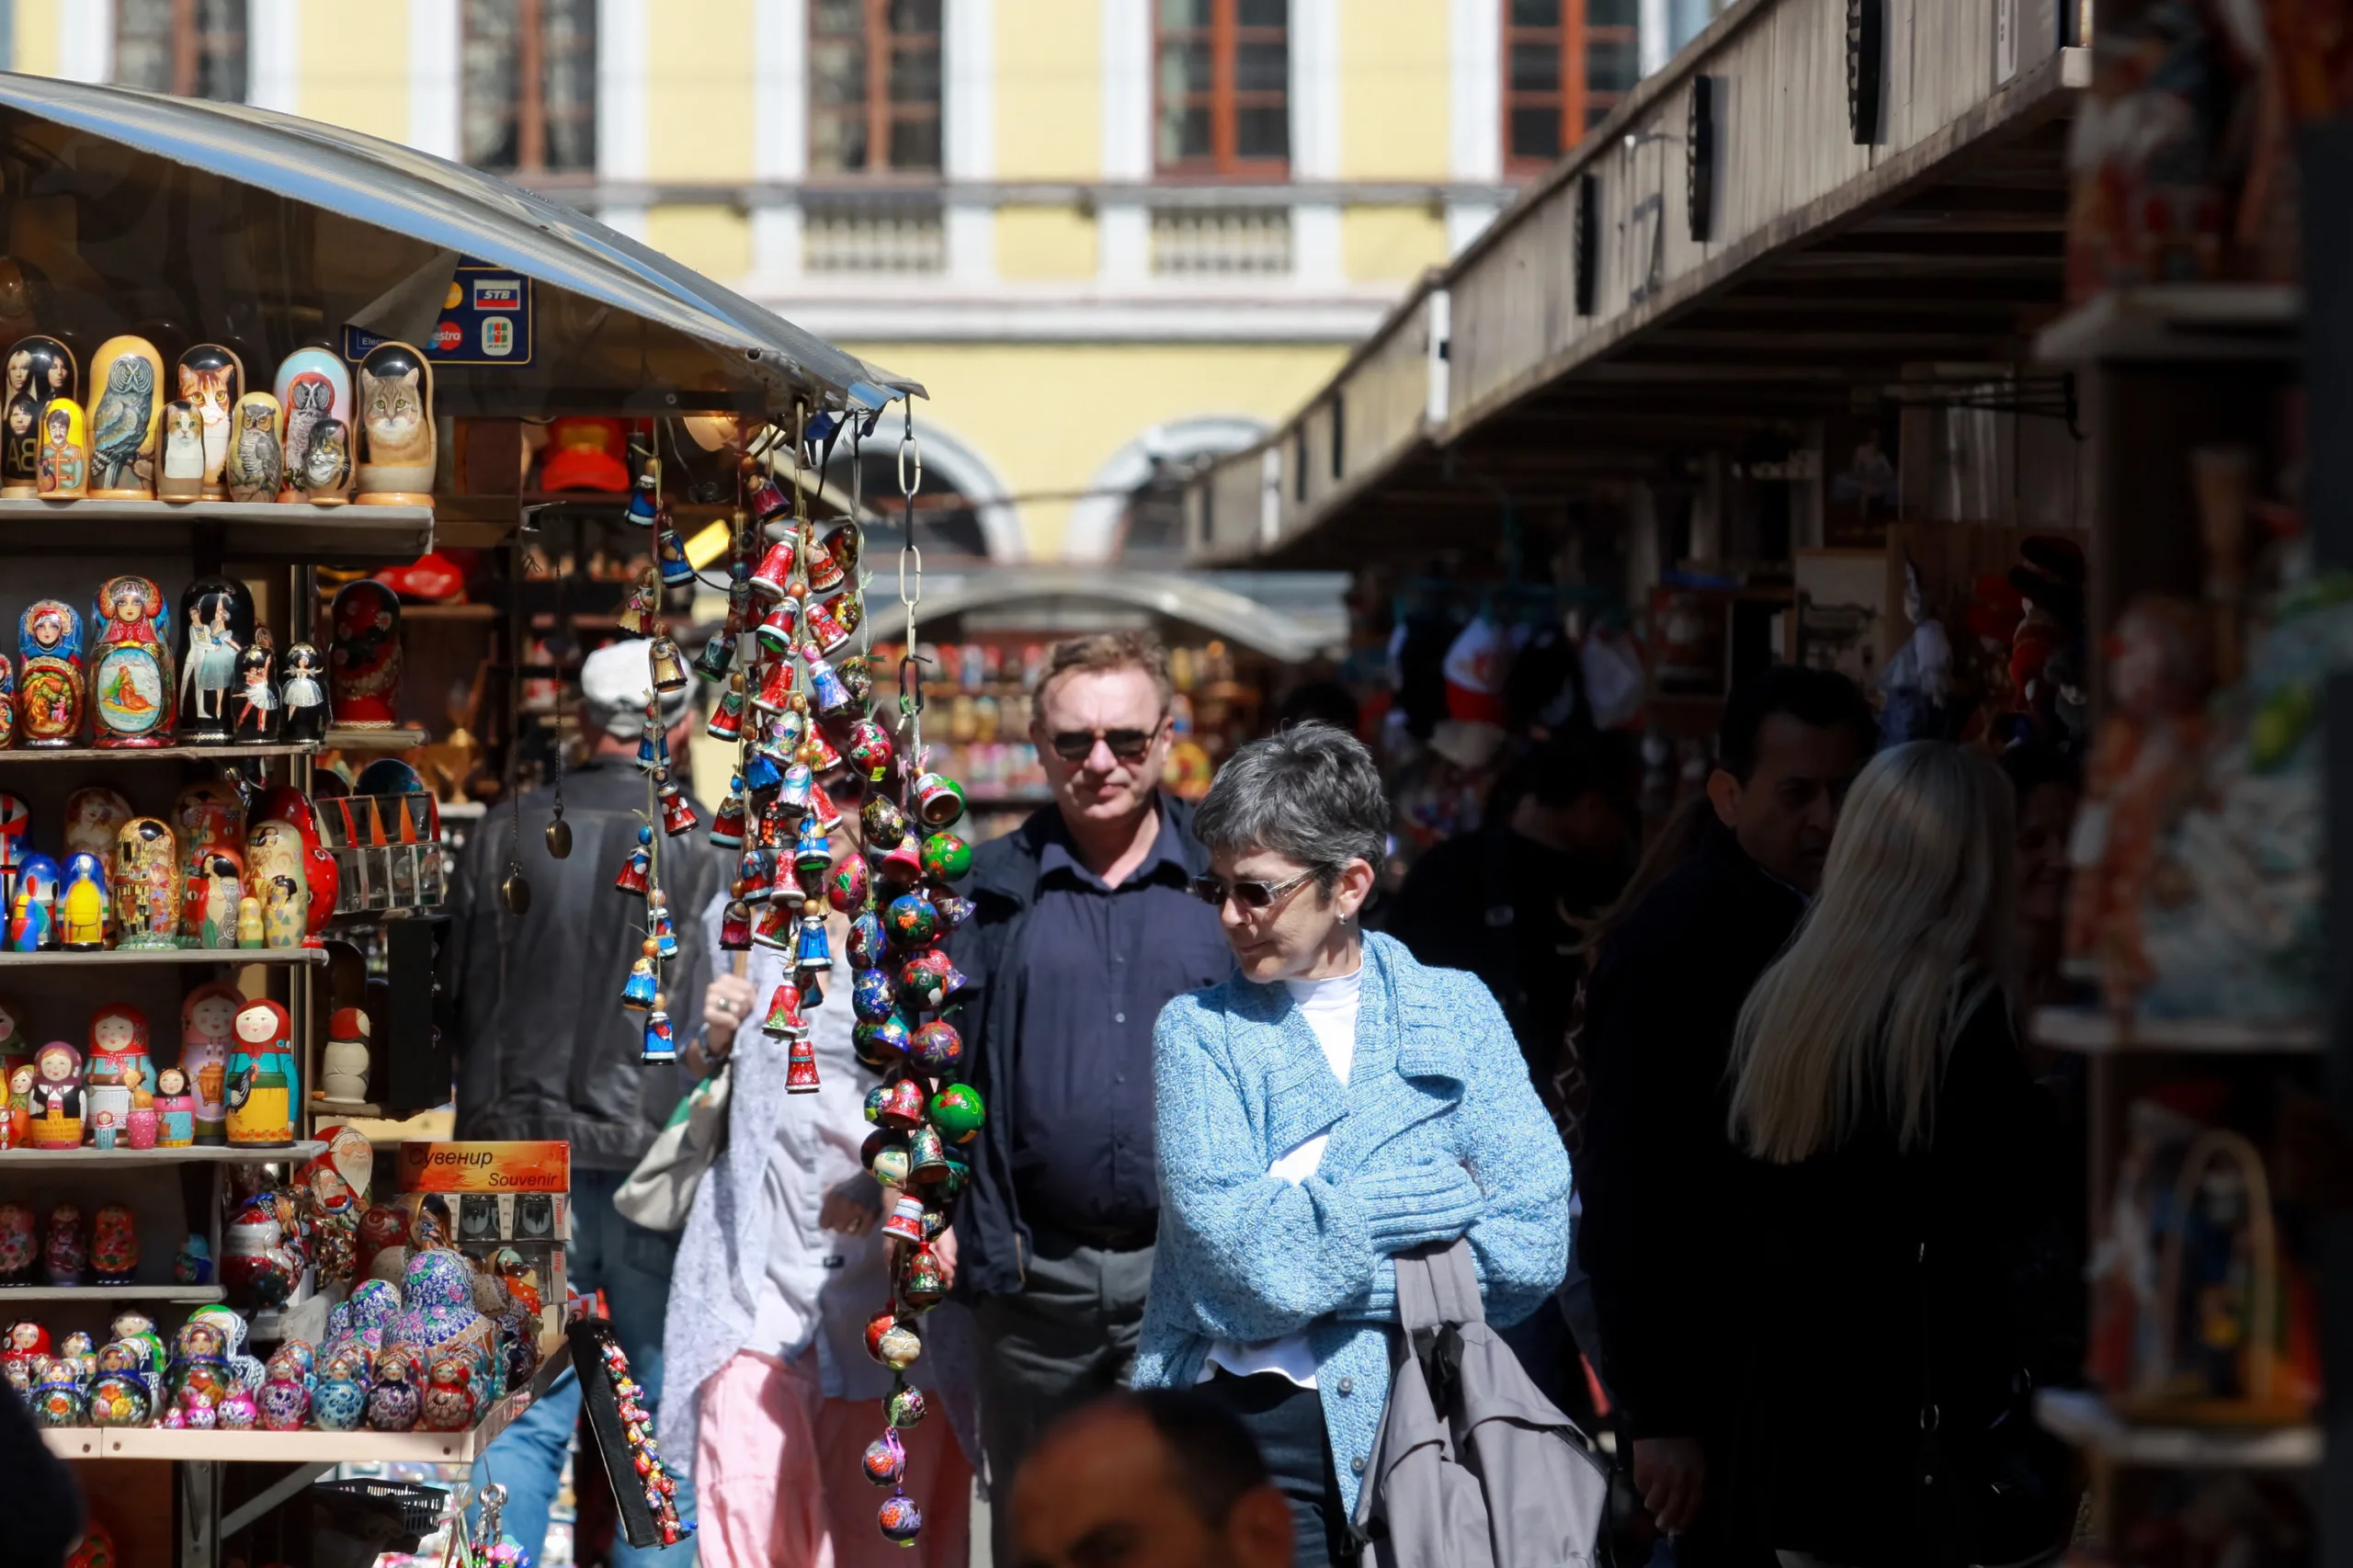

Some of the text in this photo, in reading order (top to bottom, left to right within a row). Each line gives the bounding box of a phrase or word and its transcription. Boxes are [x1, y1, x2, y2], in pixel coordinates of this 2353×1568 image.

[483, 290, 510, 300] STB
[409, 1148, 493, 1169] Сувенир
[488, 1173, 558, 1187] Souvenir
